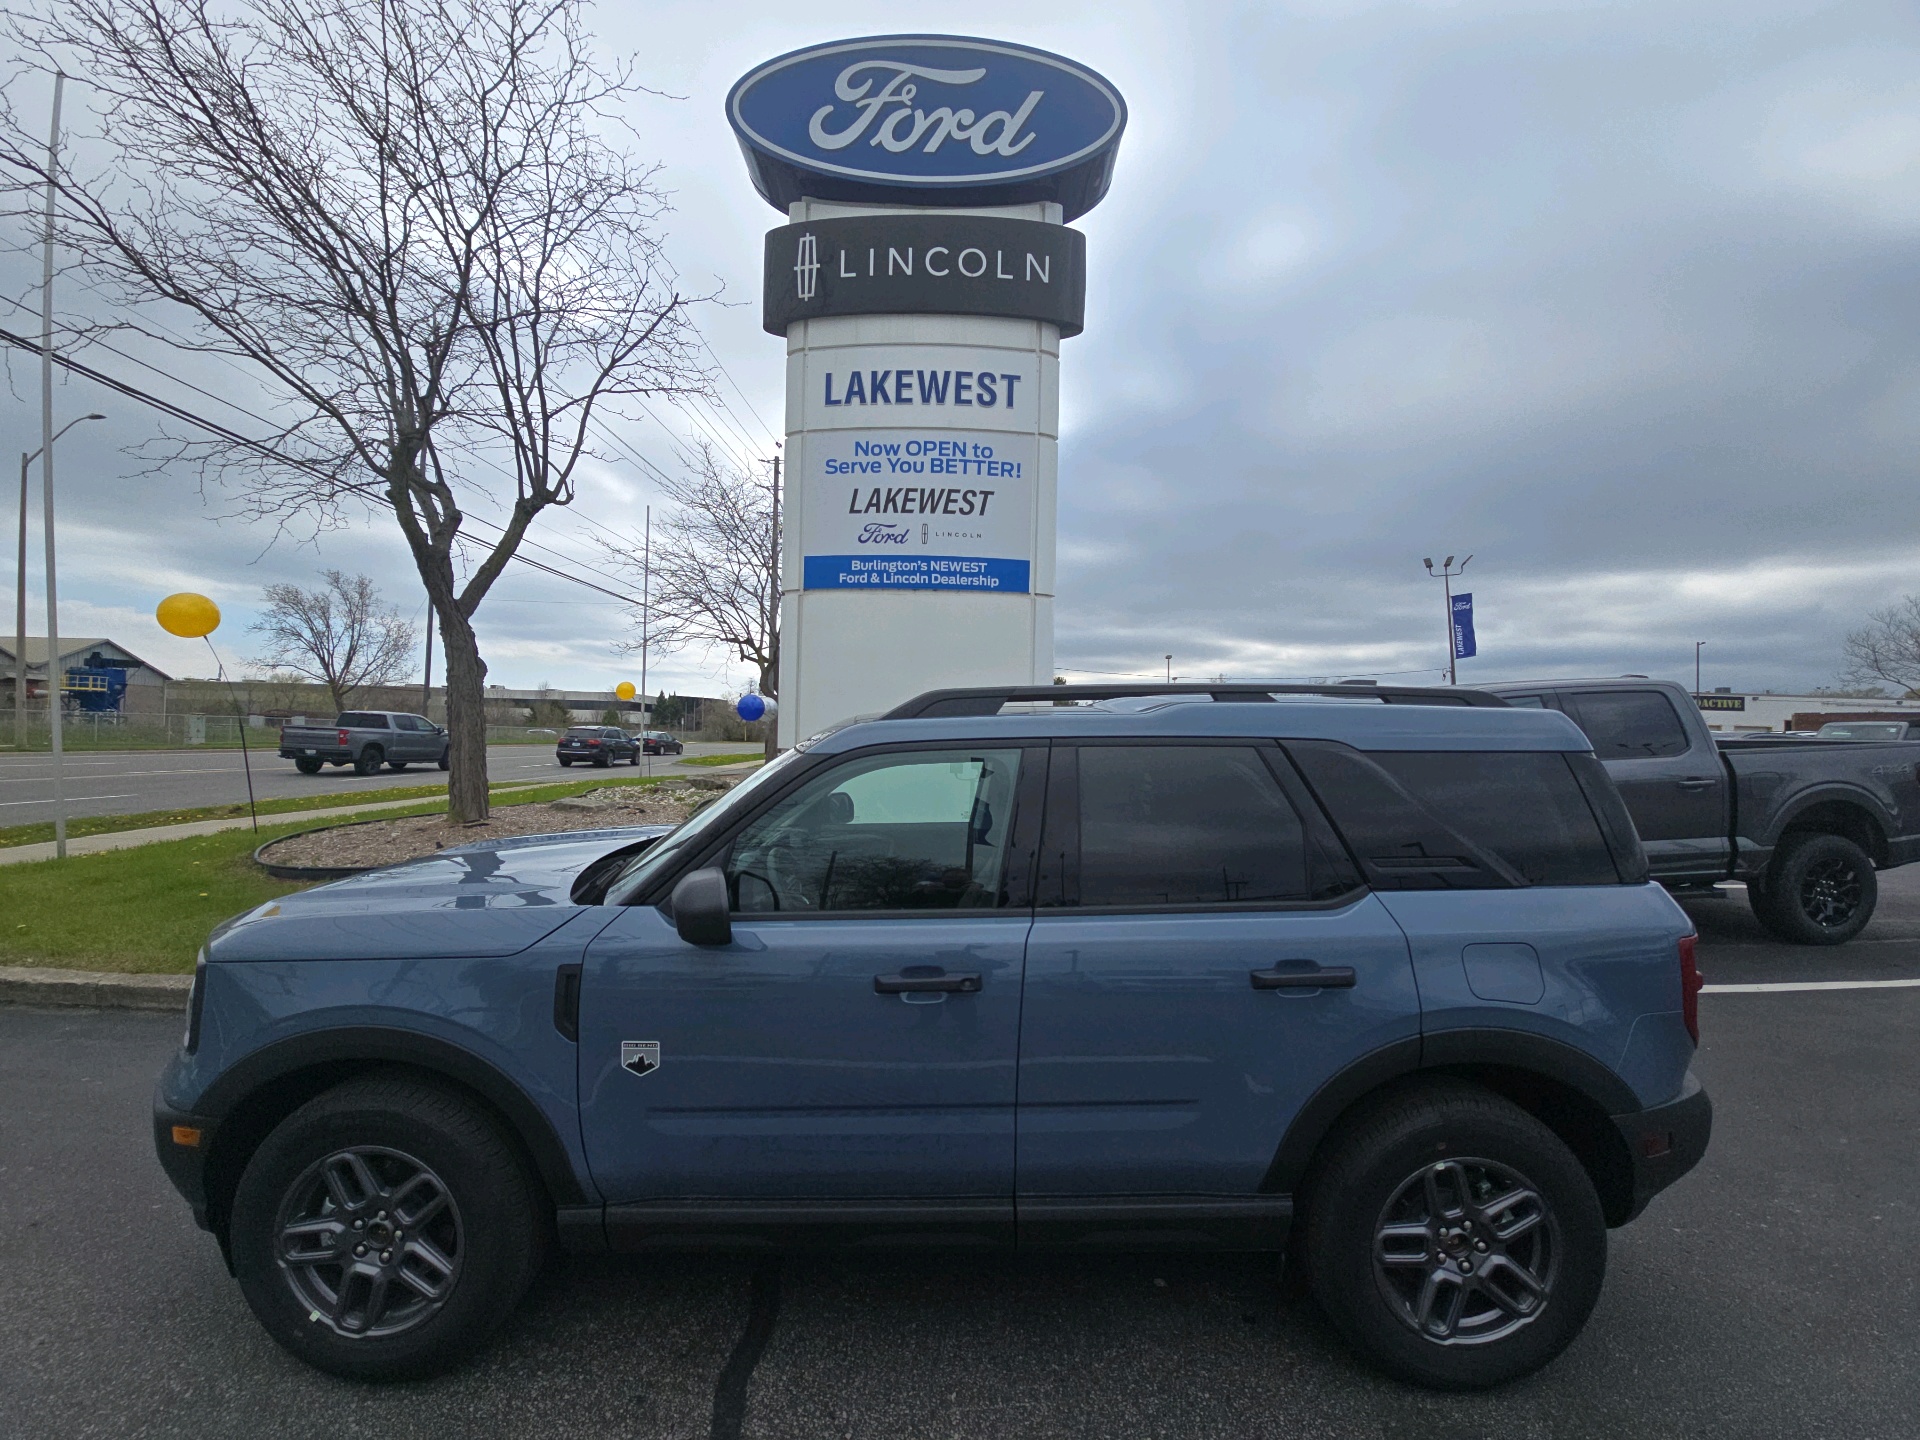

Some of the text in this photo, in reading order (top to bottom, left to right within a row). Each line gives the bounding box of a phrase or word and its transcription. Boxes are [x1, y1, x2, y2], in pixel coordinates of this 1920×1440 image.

[808, 60, 1044, 156] Ford
[840, 246, 1050, 283] LINCOLN
[824, 369, 1022, 409] LAKEWEST
[854, 440, 994, 459] Now OPEN to
[825, 458, 1022, 479] Serve You BETTER!
[848, 487, 995, 516] LAKEWEST
[857, 522, 910, 545] Ford
[935, 531, 983, 539] LINCOLN
[851, 560, 988, 573] Burlington's NEWEST
[839, 573, 1000, 588] Ford & Lincoln Dealership
[1455, 624, 1465, 655] LAKEWEST
